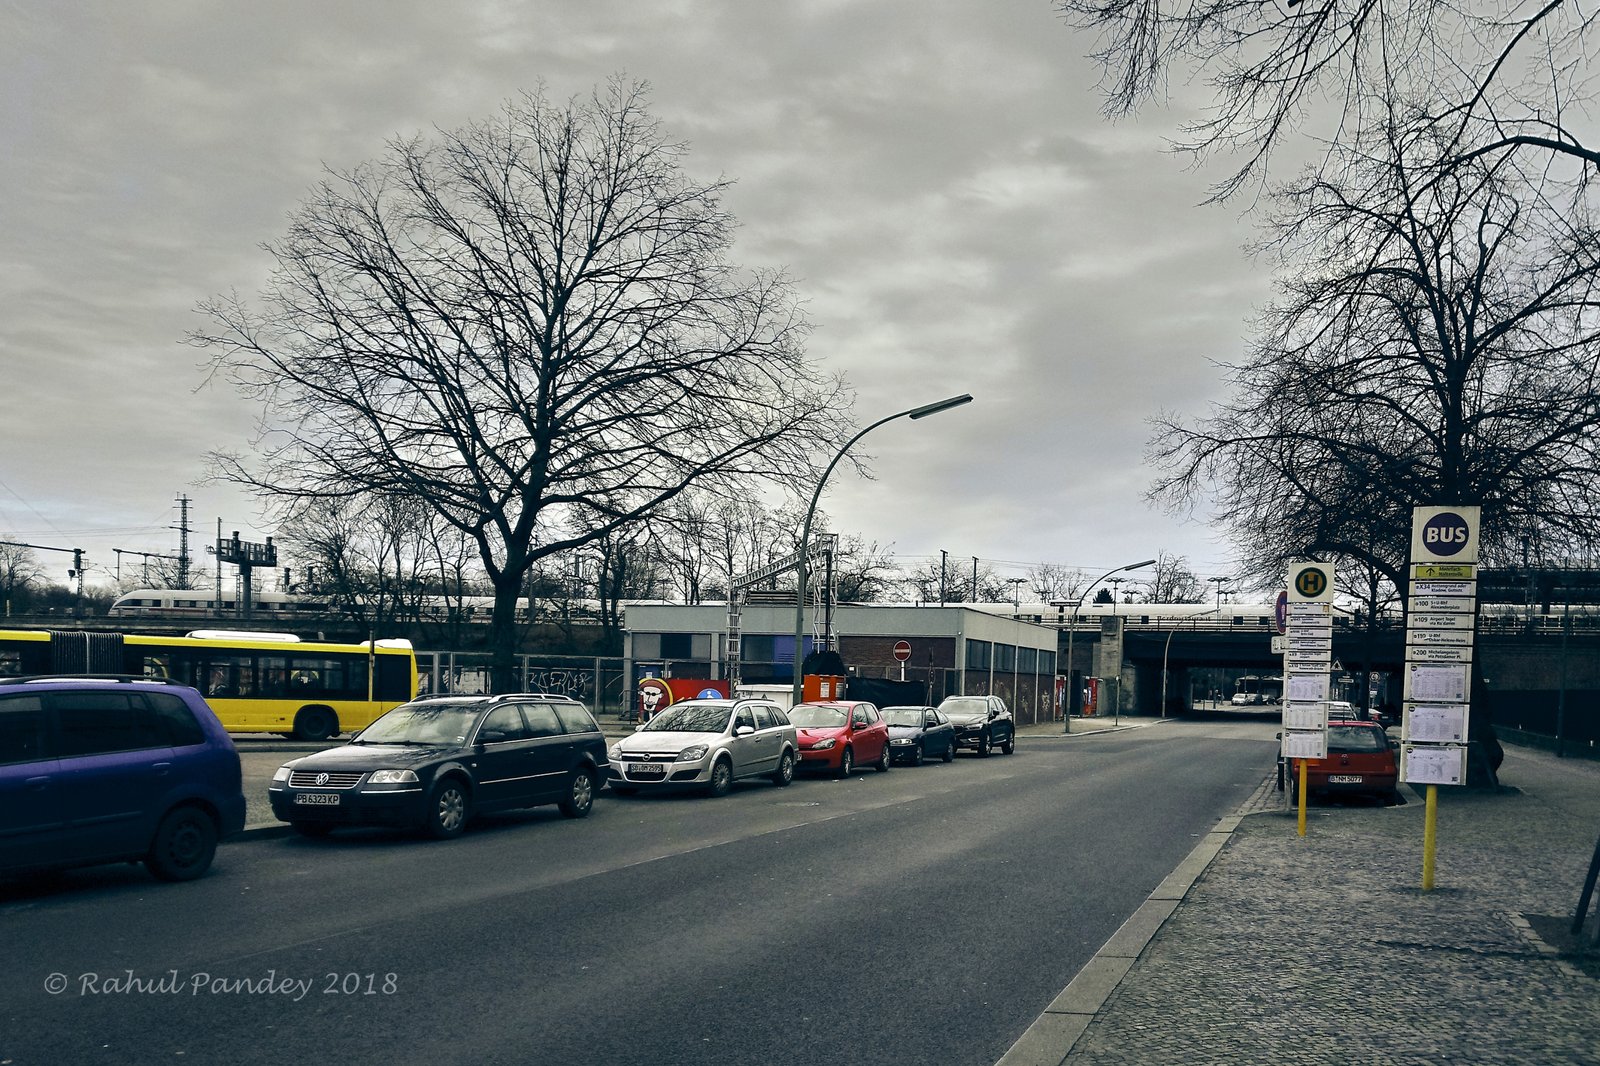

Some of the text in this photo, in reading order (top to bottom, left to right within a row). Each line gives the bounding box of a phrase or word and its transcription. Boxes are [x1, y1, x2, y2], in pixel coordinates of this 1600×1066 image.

[1426, 526, 1466, 543] BUS
[1303, 574, 1319, 590] H
[297, 794, 339, 804] PB 6323 KP
